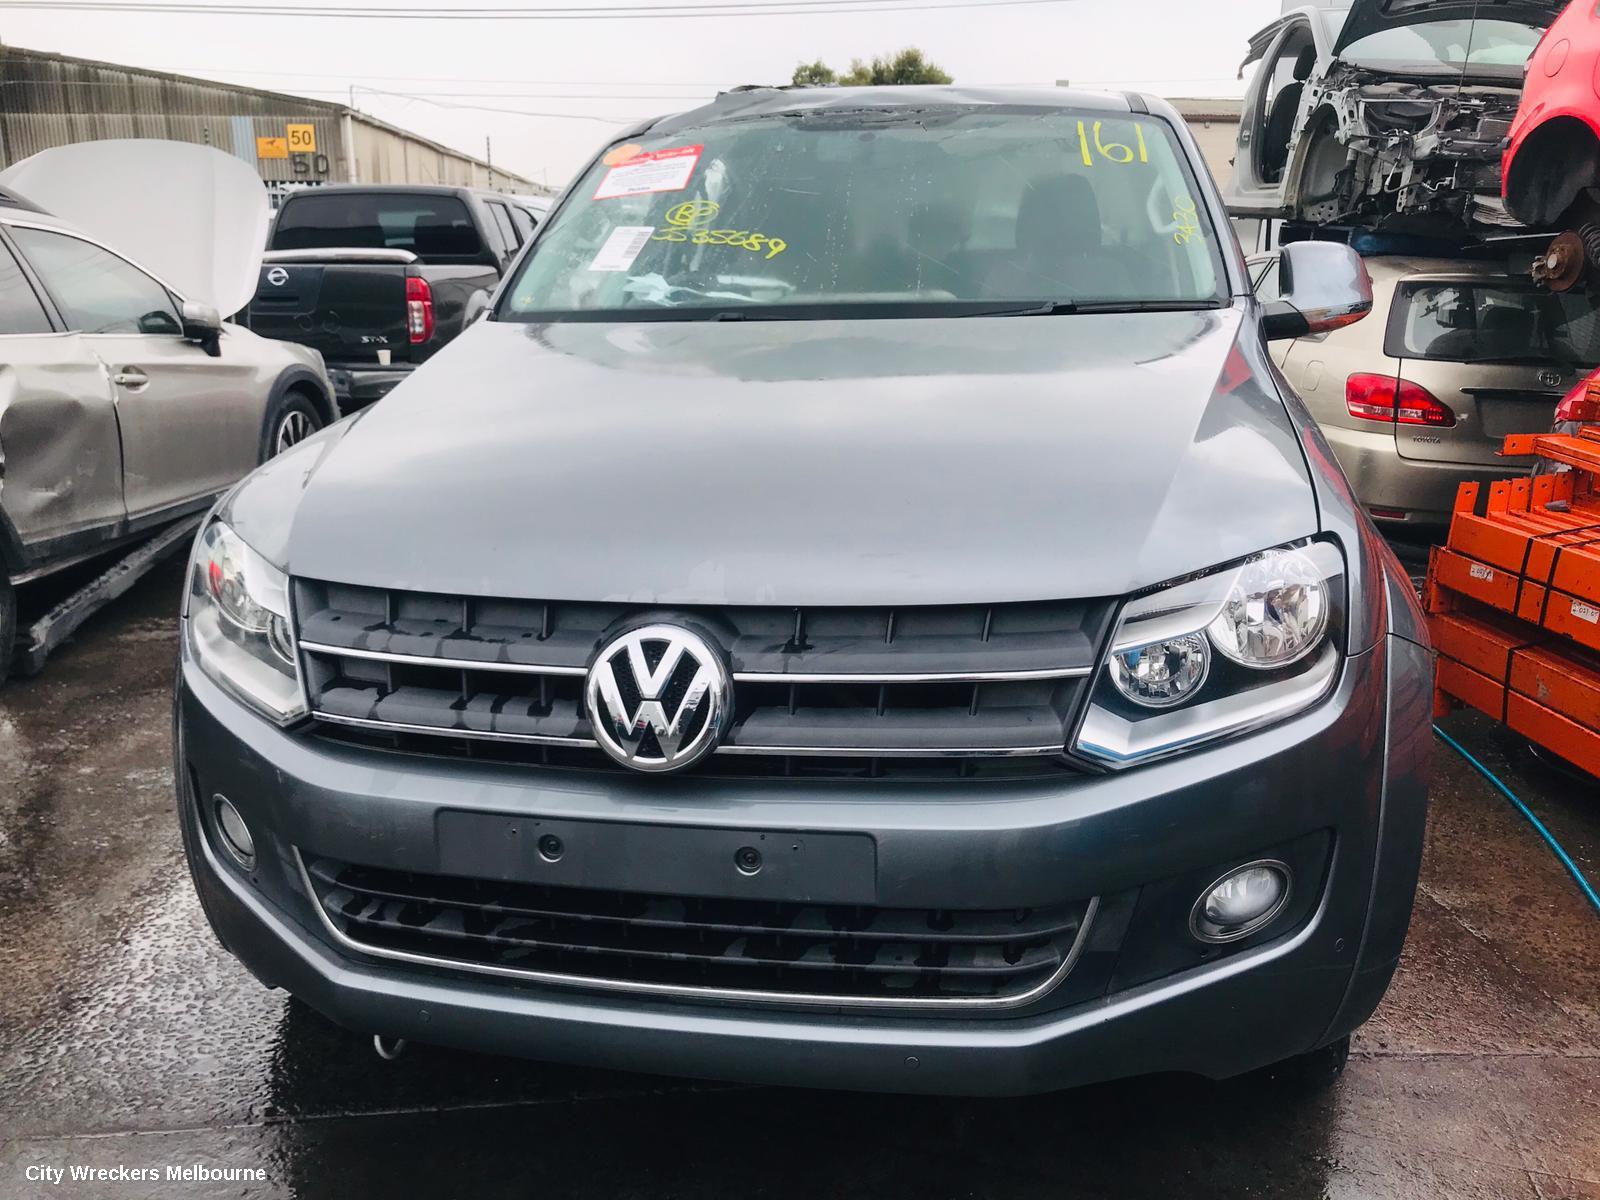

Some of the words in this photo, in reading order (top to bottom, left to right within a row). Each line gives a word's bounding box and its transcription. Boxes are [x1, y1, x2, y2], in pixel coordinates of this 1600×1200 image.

[291, 130, 312, 146] 50
[1077, 120, 1148, 167] 161
[292, 153, 330, 175] 50
[1412, 436, 1441, 444] TOYOTA
